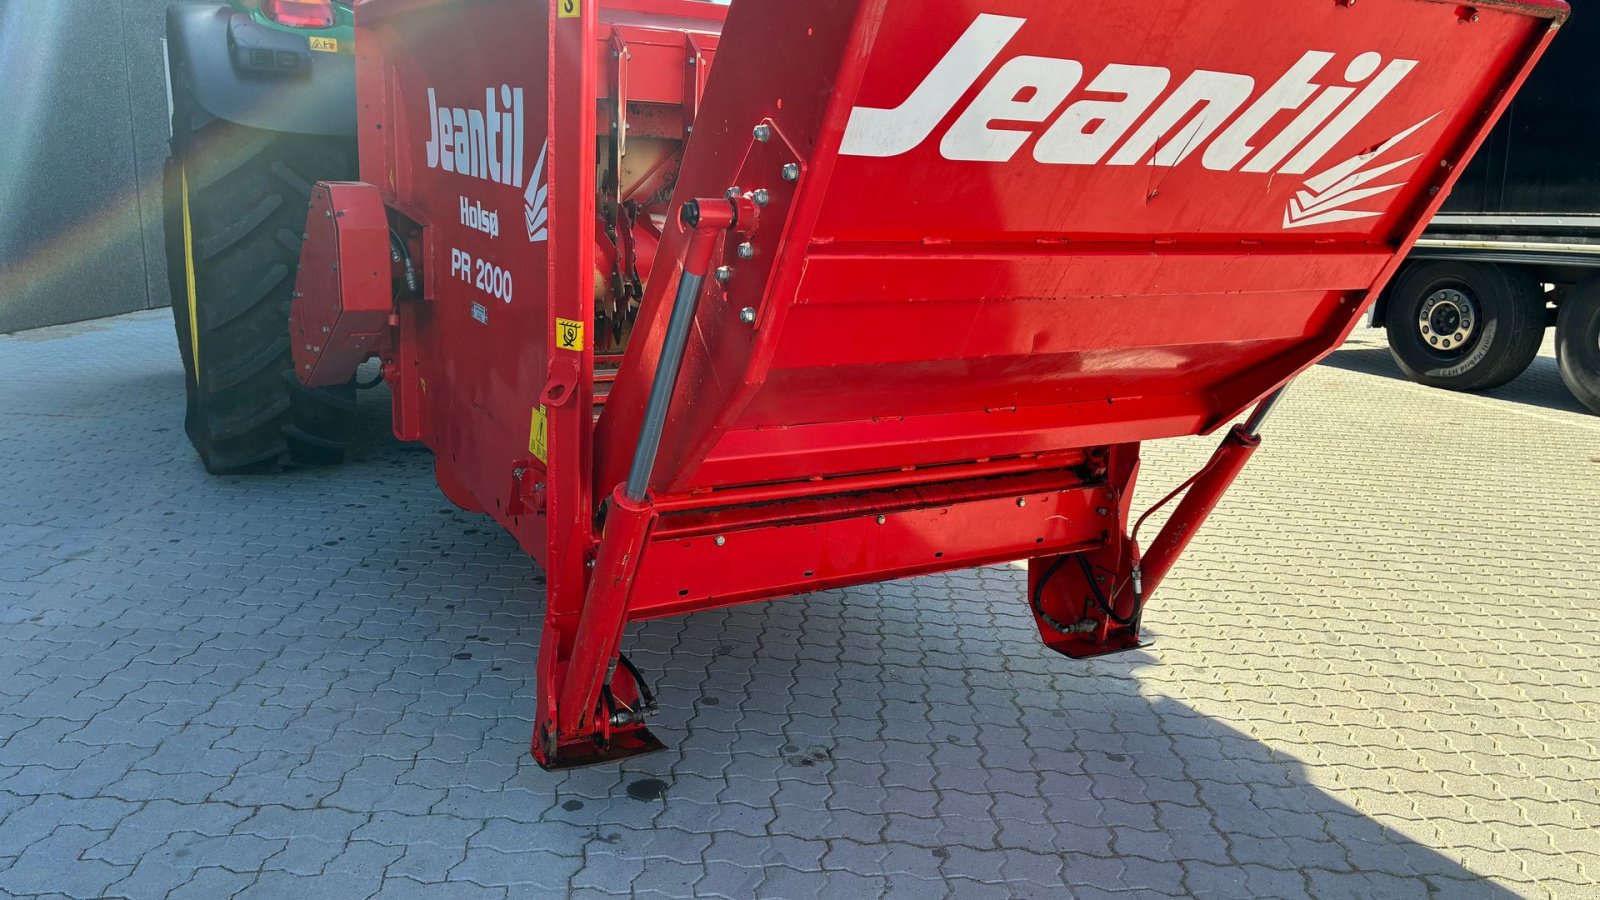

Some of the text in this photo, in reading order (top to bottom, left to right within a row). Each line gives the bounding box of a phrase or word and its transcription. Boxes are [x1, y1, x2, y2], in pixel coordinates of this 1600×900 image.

[838, 13, 1419, 174] Jeantil
[426, 84, 524, 188] Jeantil
[460, 195, 499, 239] Holsø
[451, 247, 513, 304] PR 2000
